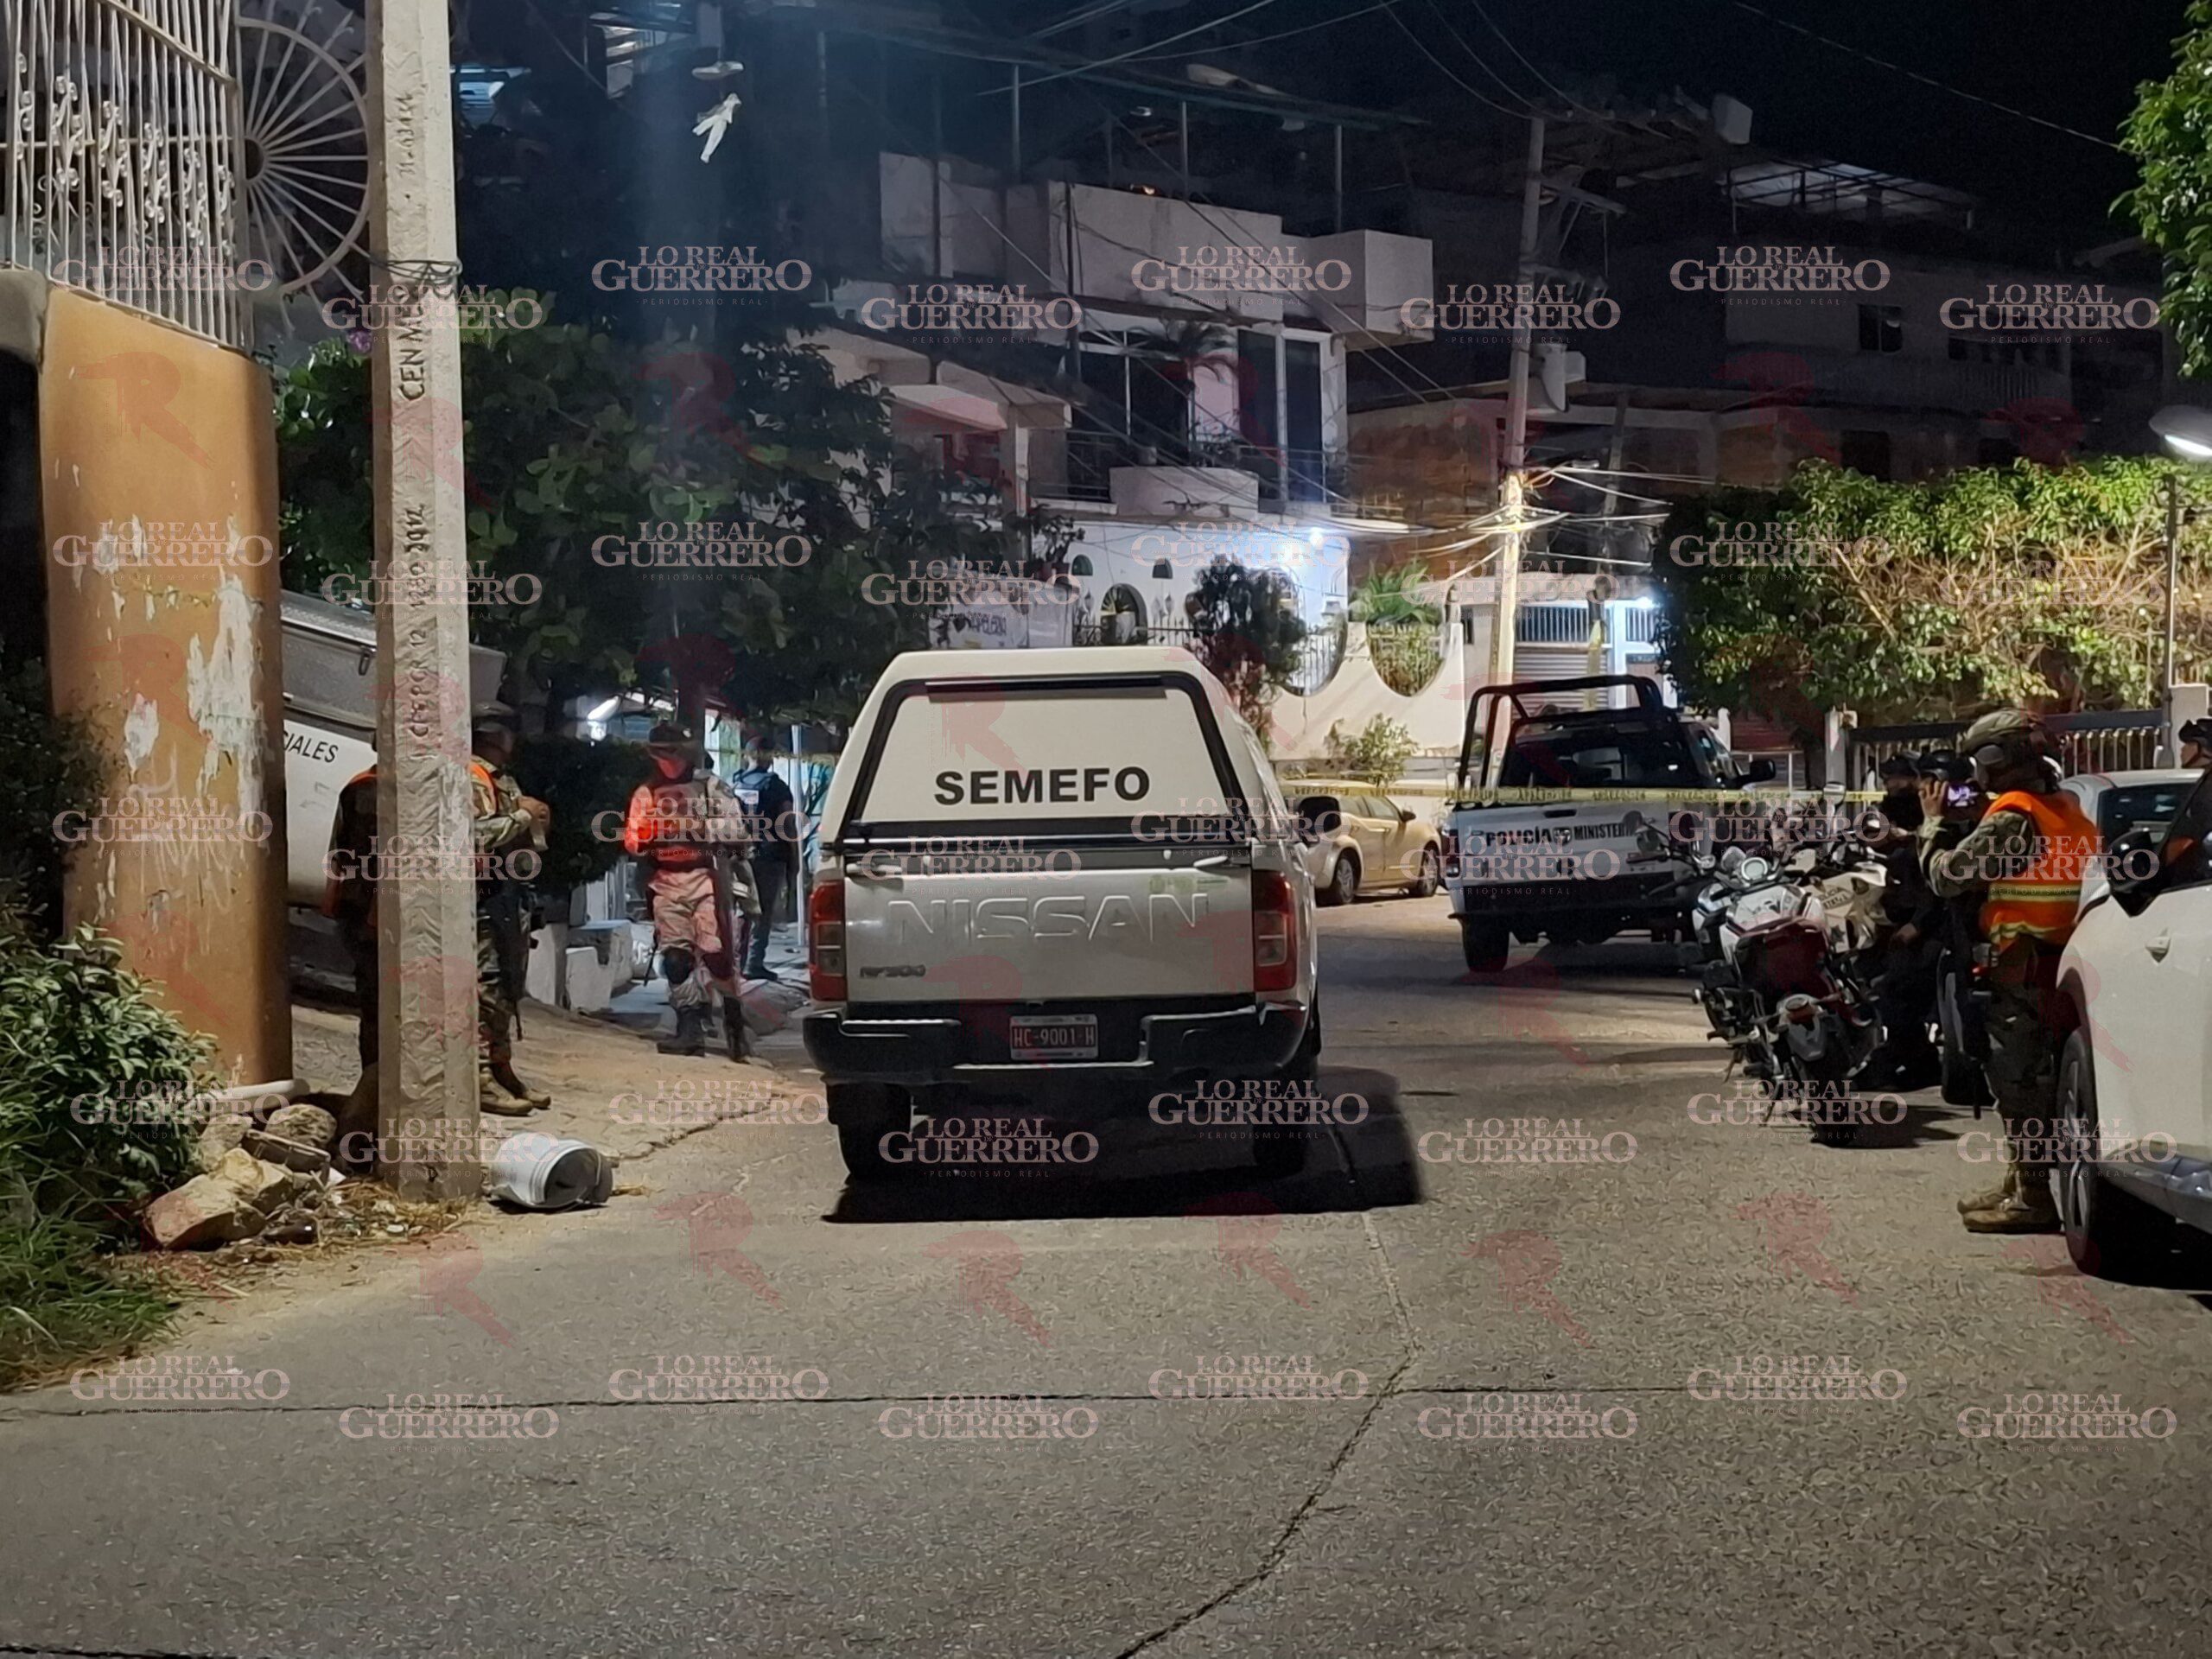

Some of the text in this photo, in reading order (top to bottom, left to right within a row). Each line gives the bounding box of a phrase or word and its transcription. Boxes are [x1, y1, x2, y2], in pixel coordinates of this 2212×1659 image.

[283, 730, 339, 763] IALES
[934, 766, 1150, 805] SEMEFO
[888, 893, 1208, 943] NISSAN
